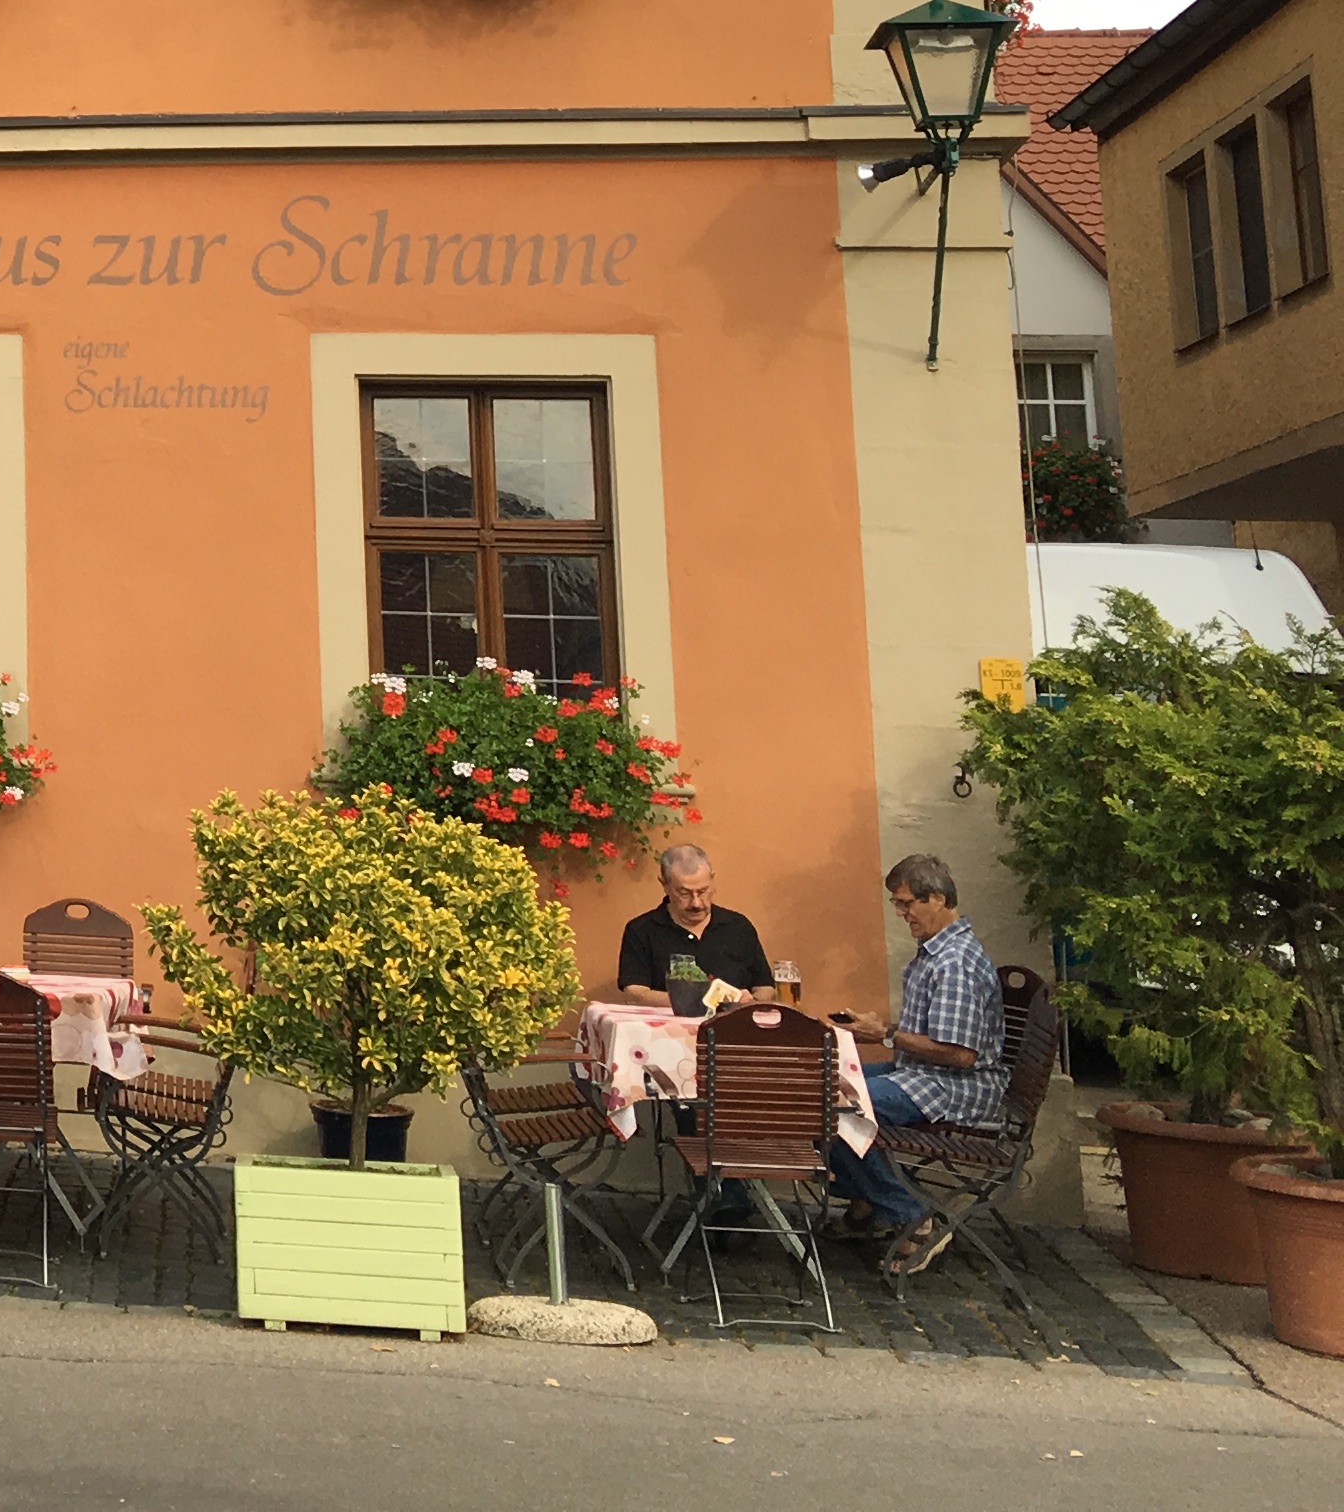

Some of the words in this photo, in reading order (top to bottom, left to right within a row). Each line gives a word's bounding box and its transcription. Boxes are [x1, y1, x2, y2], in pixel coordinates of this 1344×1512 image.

[86, 233, 227, 286] zur
[251, 195, 638, 296] Schranne
[63, 336, 130, 370] eigene
[64, 369, 271, 424] Schlachtung
